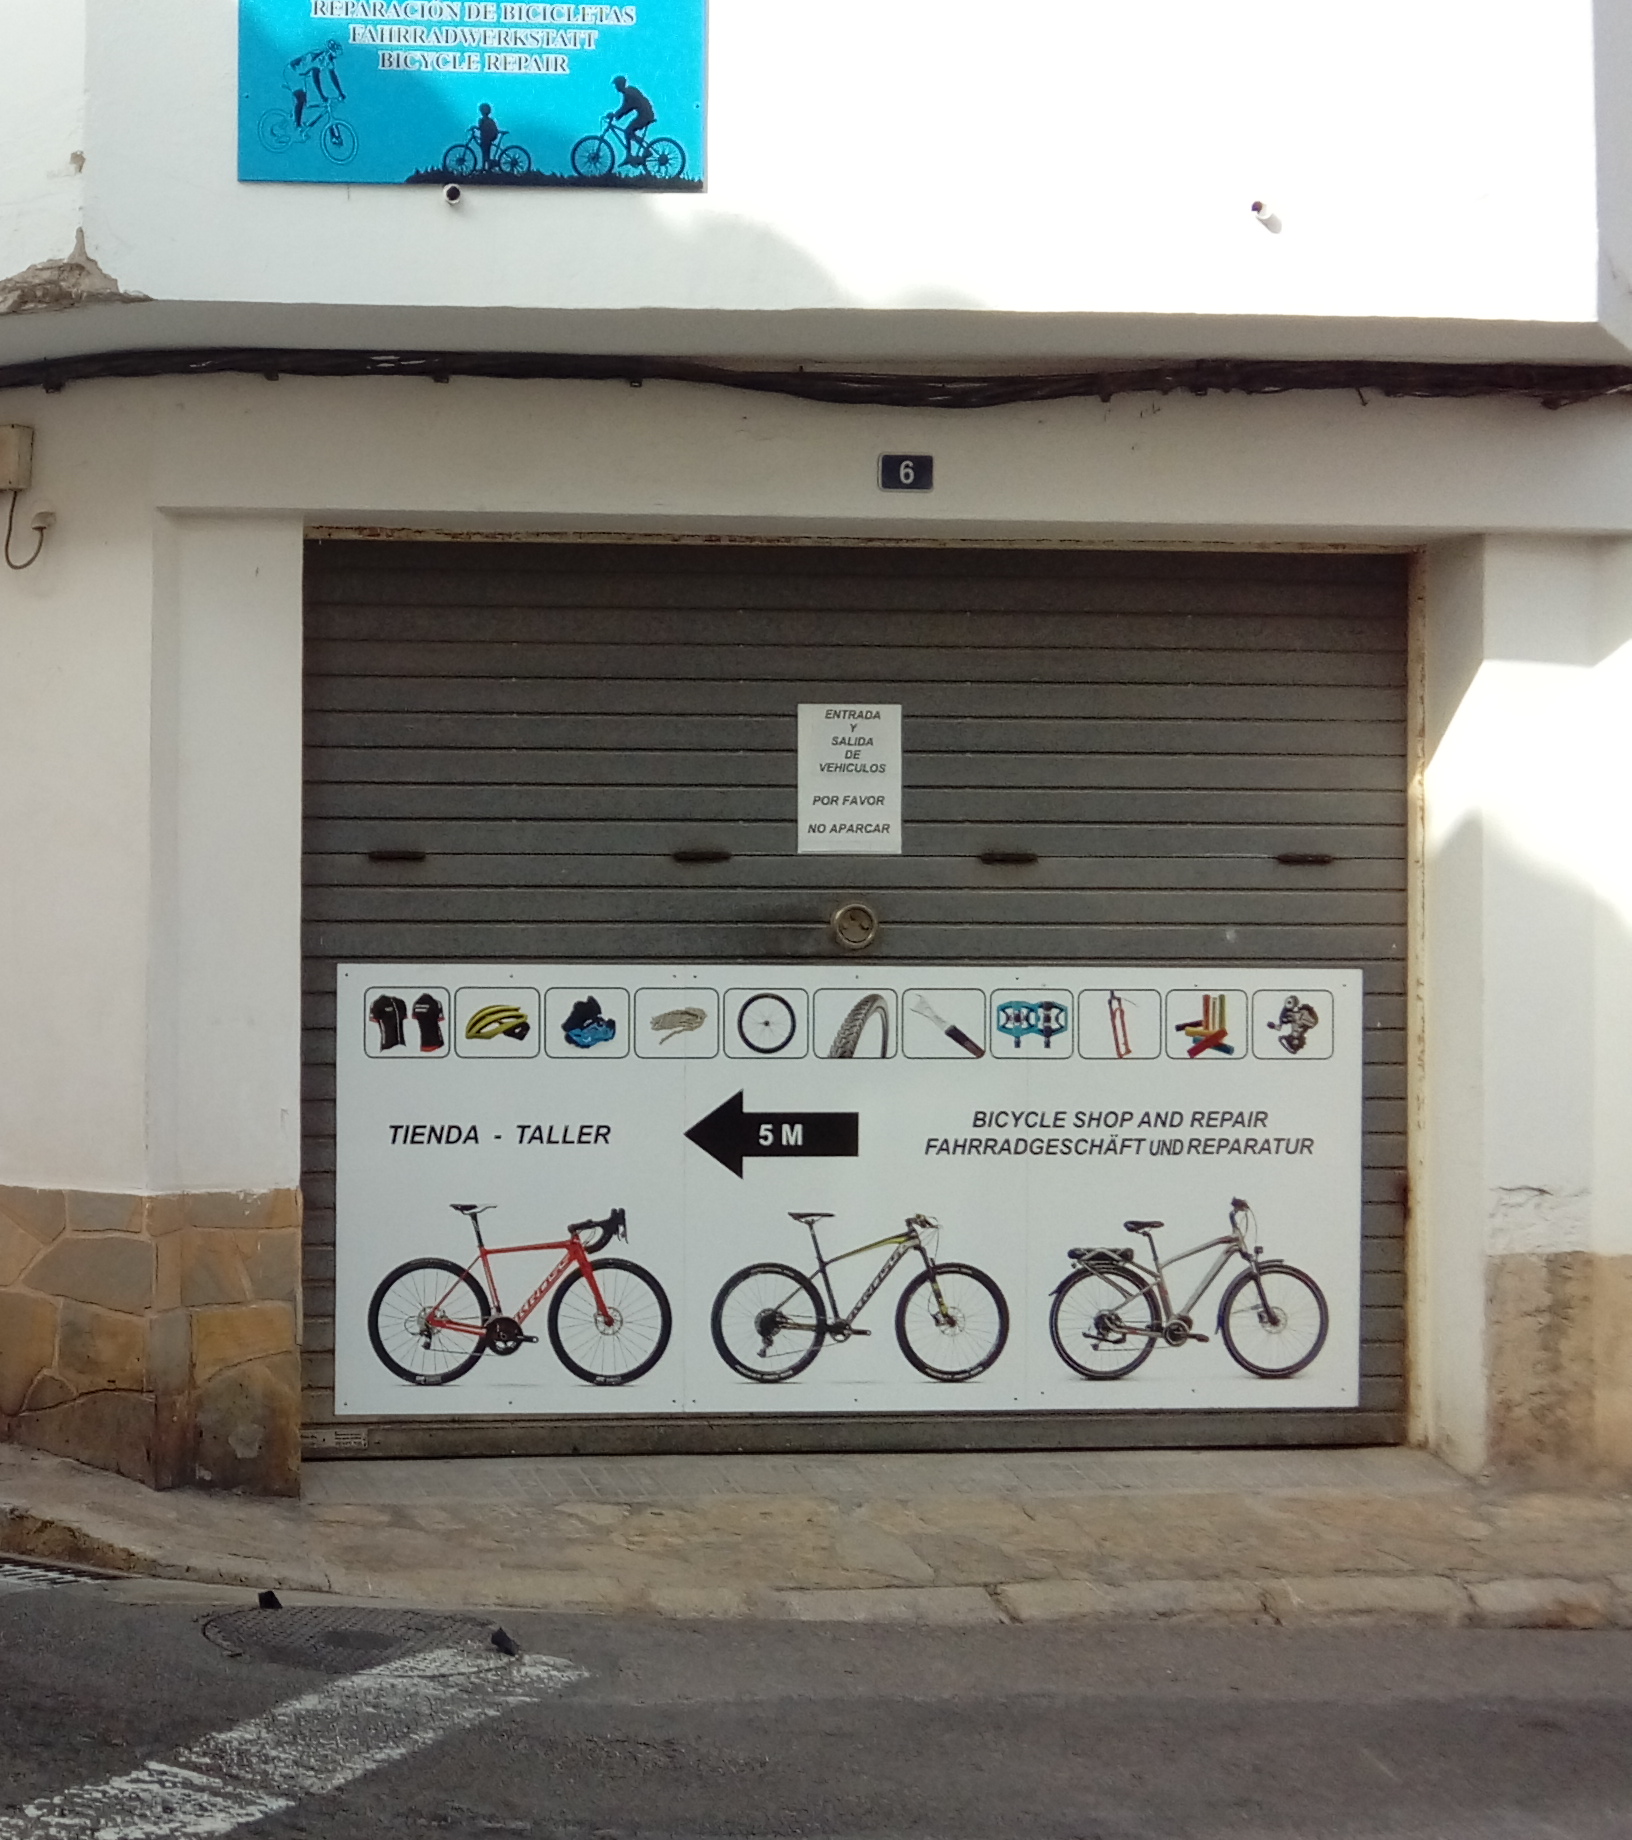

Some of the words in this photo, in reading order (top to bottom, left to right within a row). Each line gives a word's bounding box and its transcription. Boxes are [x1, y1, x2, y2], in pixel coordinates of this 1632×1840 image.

[311, 0, 460, 21] REPARACIÓN
[464, 2, 497, 21] DE
[501, 4, 636, 24] BICICLETAS
[349, 25, 597, 48] FAHRRADWERKSTATT
[378, 51, 479, 70] BICYCLE
[485, 54, 570, 73] REPAIR
[899, 460, 915, 484] 6
[825, 709, 881, 720] ENTRADA
[850, 723, 858, 733] Y
[831, 736, 874, 746] SALIDA
[844, 750, 861, 759] DE
[819, 763, 886, 773] VEHICULOS
[813, 796, 839, 806] POR
[842, 796, 885, 806] FAVOR
[808, 824, 826, 833] NO
[829, 824, 890, 833] APARCAR
[972, 1111, 1067, 1129] BICYCLE
[1072, 1111, 1134, 1129] SHOP
[1137, 1111, 1184, 1128] AND
[1189, 1111, 1269, 1128] REPAIR
[389, 1125, 480, 1145] TIENDA
[516, 1125, 611, 1145] TALLER
[758, 1125, 774, 1146] 5
[781, 1126, 804, 1145] M
[924, 1135, 1147, 1156] FAHRRADGESCHÄFT
[1149, 1140, 1184, 1156] UND
[1187, 1138, 1315, 1156] REPARATUR
